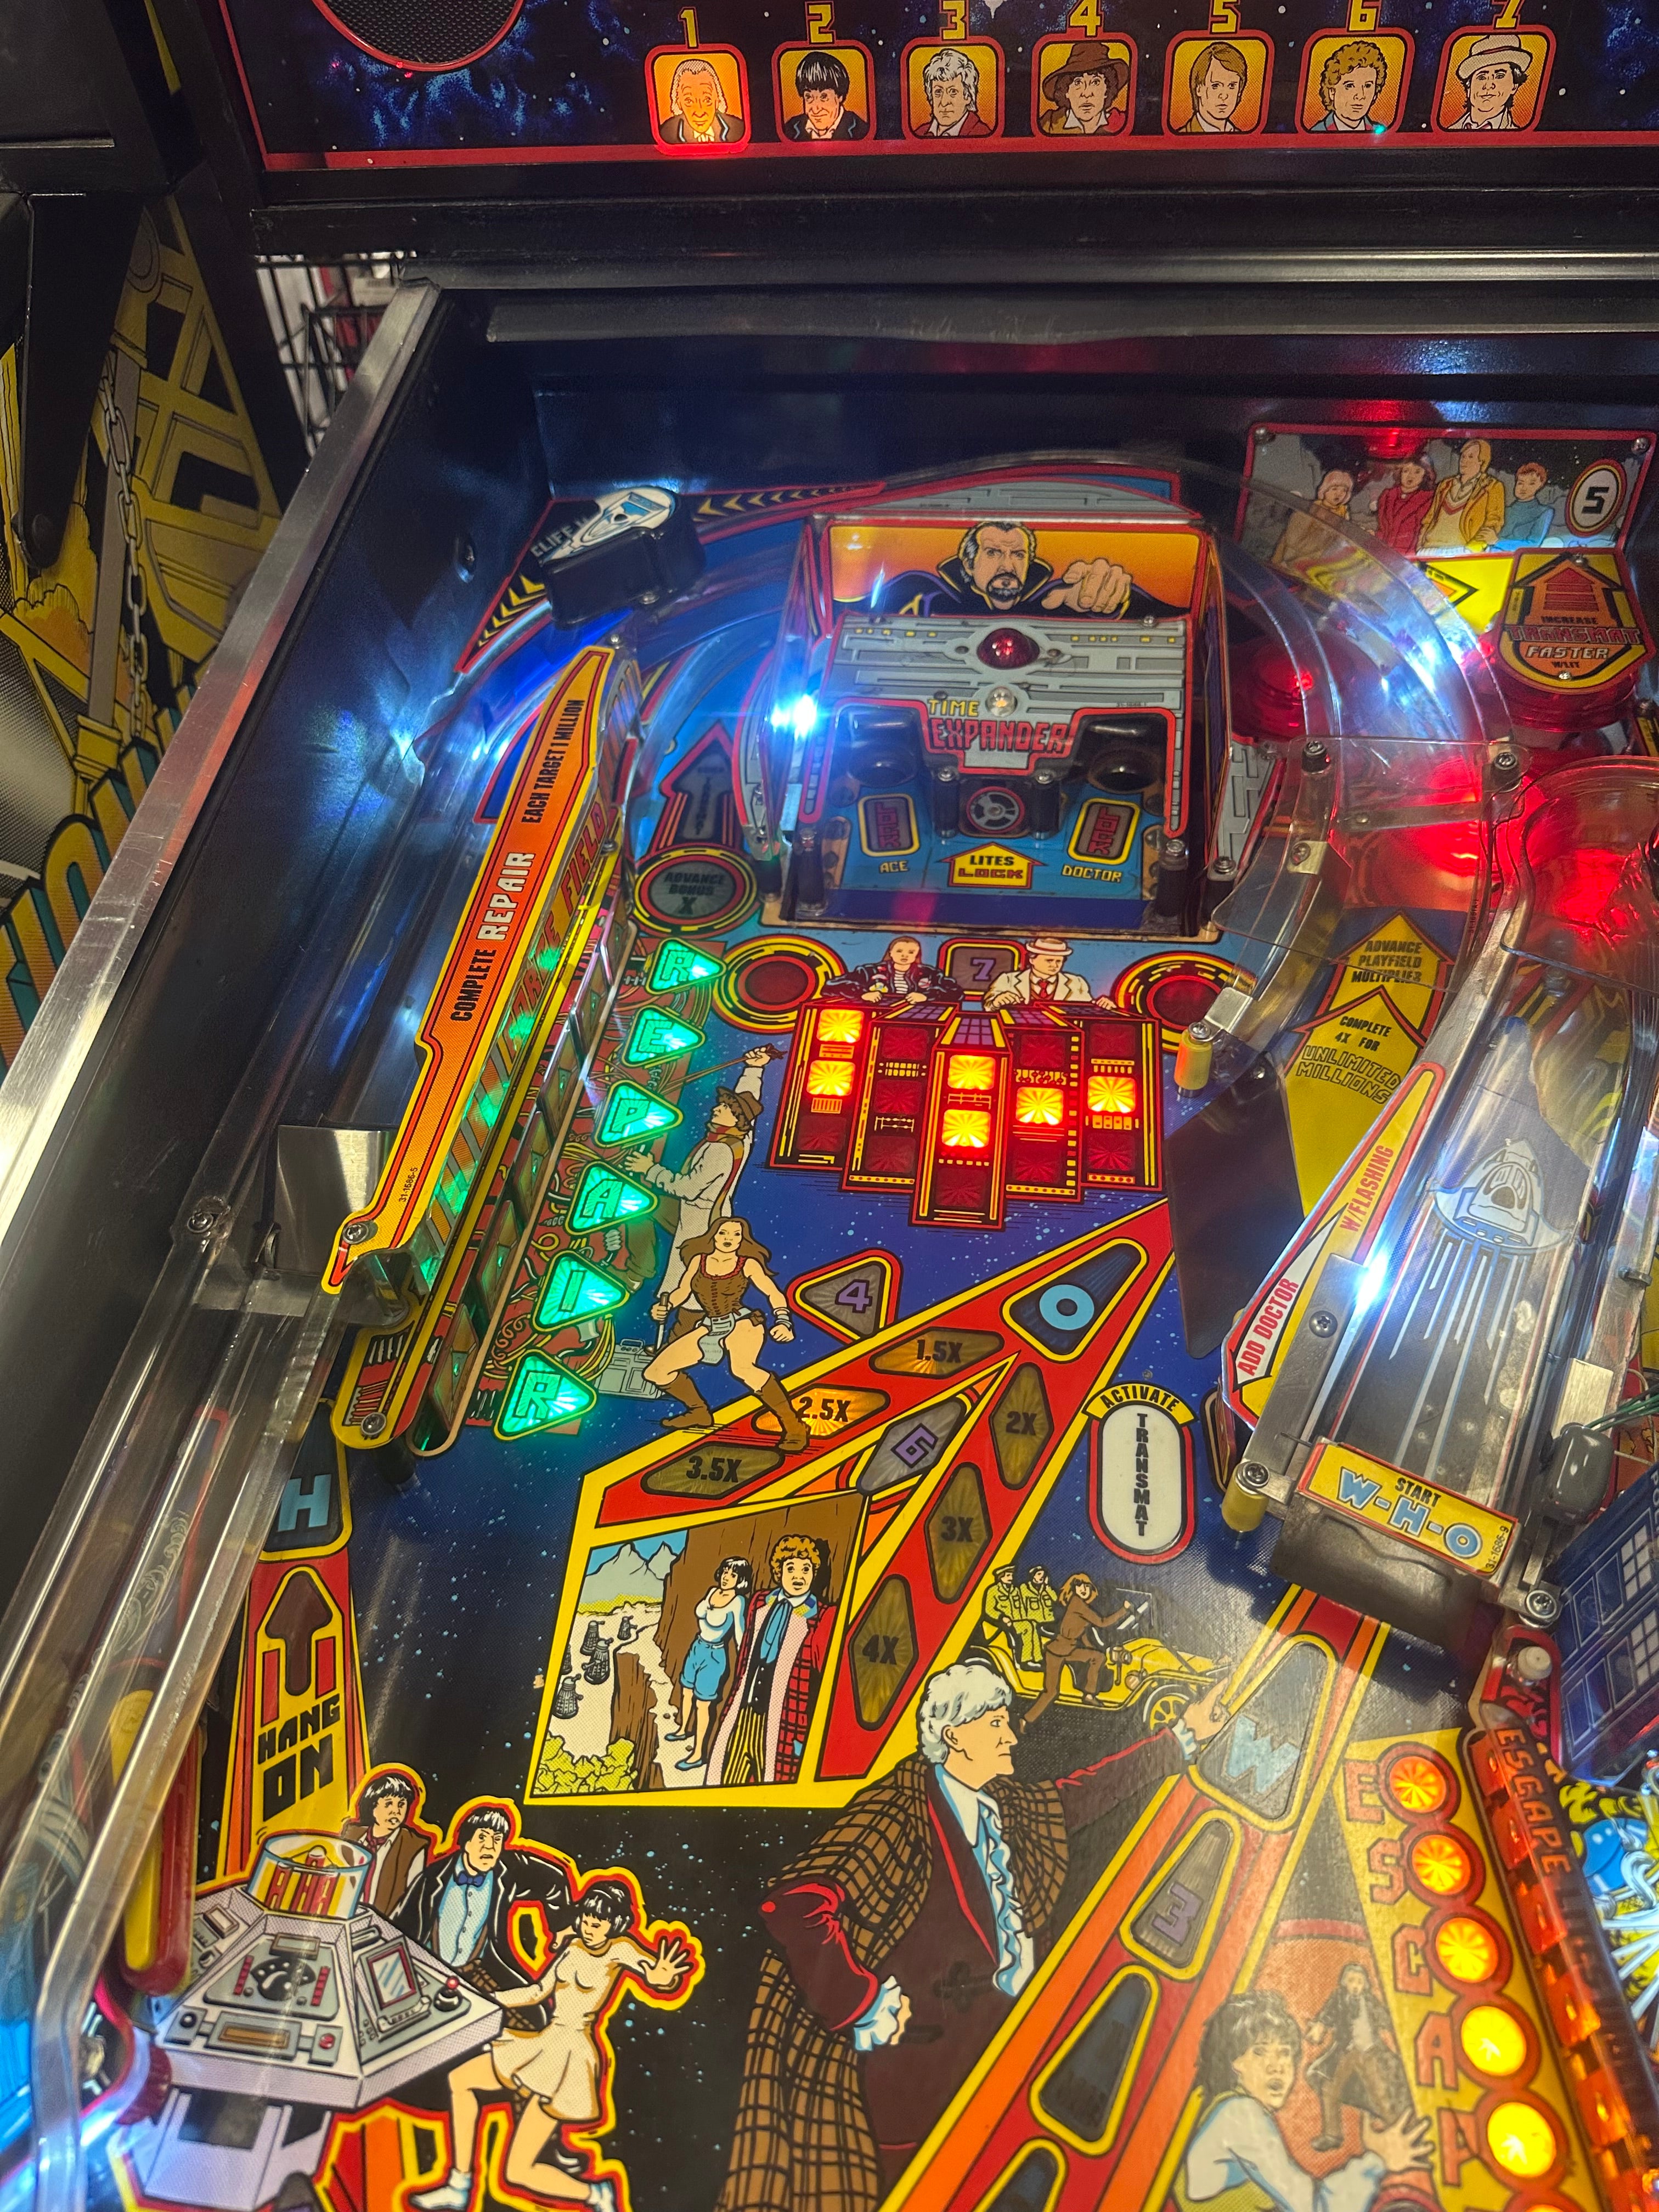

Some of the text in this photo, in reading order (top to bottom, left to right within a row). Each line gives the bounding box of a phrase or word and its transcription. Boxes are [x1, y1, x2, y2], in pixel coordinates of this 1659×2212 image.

[681, 0, 1523, 48] 1 2 3 4 5 6 7
[1581, 487, 1611, 514] 5
[1504, 625, 1641, 645] TRANSMAT
[1526, 645, 1609, 659] FASTER
[553, 700, 585, 740] MILLION
[928, 699, 979, 716] TIME
[930, 718, 1069, 753] EXPANDER
[534, 749, 566, 790] TARGET
[521, 792, 550, 823] EACH
[561, 801, 607, 917] FIELD
[879, 860, 910, 873] ACE
[958, 868, 1023, 879] LOCK
[969, 855, 1014, 867] LITES
[1062, 864, 1122, 883] DOCTOR
[477, 852, 535, 941] REPAIR
[679, 896, 698, 915] X
[1358, 955, 1422, 968] PLAYFIELD
[1364, 940, 1422, 953] ADVANCE
[450, 948, 497, 1022] COMPLETE
[972, 957, 998, 982] 7
[1351, 970, 1422, 983] MULTIPLIER
[1335, 1032, 1380, 1052] 4X FOR
[1339, 1016, 1392, 1037] COMPLETE
[1296, 1062, 1392, 1104] MILLIONS
[1301, 1045, 1401, 1091] UNLIMITED
[1238, 1145, 1394, 1377] ADD DOCTOR W/FLASHING
[835, 1278, 873, 1314] 4
[915, 1338, 964, 1363] 1.5X
[799, 1395, 851, 1423] 2.5X
[1102, 1383, 1180, 1413] ACTIVATE
[1006, 1412, 1037, 1435] 2X
[890, 1423, 938, 1468] 6
[686, 1457, 742, 1482] 3.5X
[1135, 1413, 1150, 1537] TRANSMAT
[276, 1474, 332, 1532] H
[1395, 1477, 1441, 1508] START
[1337, 1466, 1483, 1559] W-H-O
[941, 1516, 974, 1543] 3X
[861, 1634, 898, 1664] 4X
[258, 1693, 340, 1765] HANG
[1221, 1714, 1301, 1793] W
[263, 1733, 334, 1822] ON
[1496, 1729, 1572, 1874] ESCAPE
[1152, 1883, 1204, 1947] 3
[1343, 1758, 1490, 2212] ESCAP
